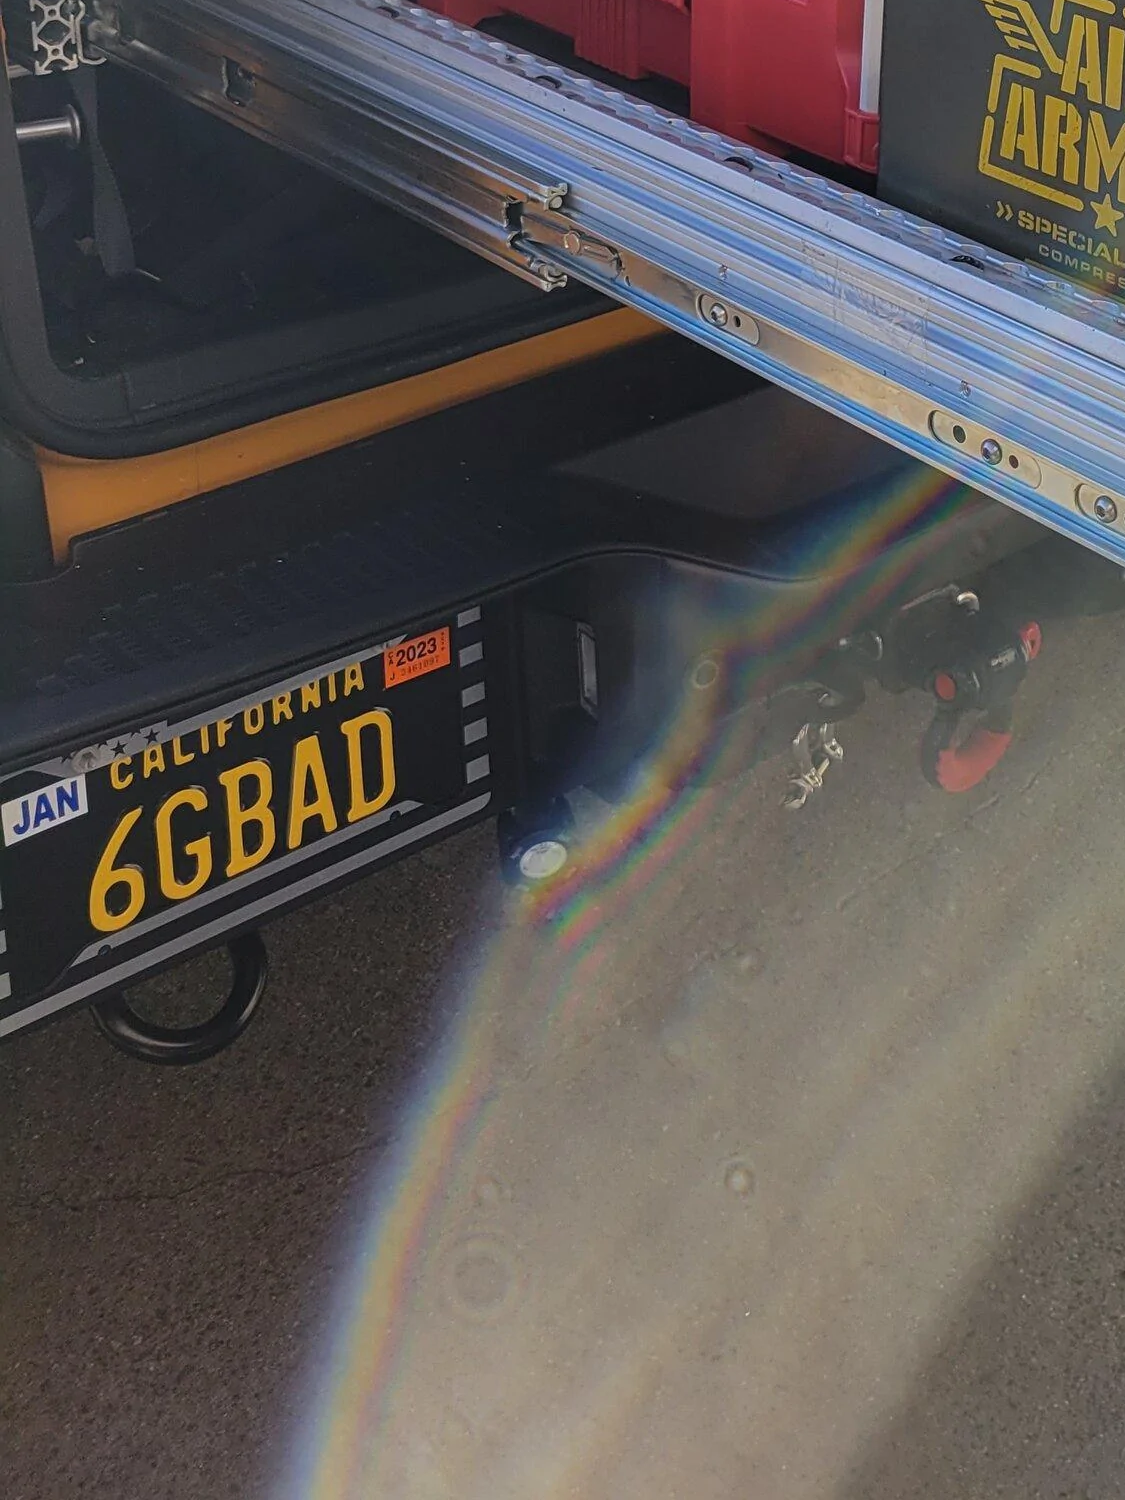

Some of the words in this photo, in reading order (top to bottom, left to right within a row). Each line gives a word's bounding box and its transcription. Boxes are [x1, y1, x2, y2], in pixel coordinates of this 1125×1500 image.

[395, 636, 438, 668] 2023
[109, 661, 366, 791] CALIFORNIA
[12, 779, 80, 836] JAN
[88, 707, 397, 933] 6GBAD
